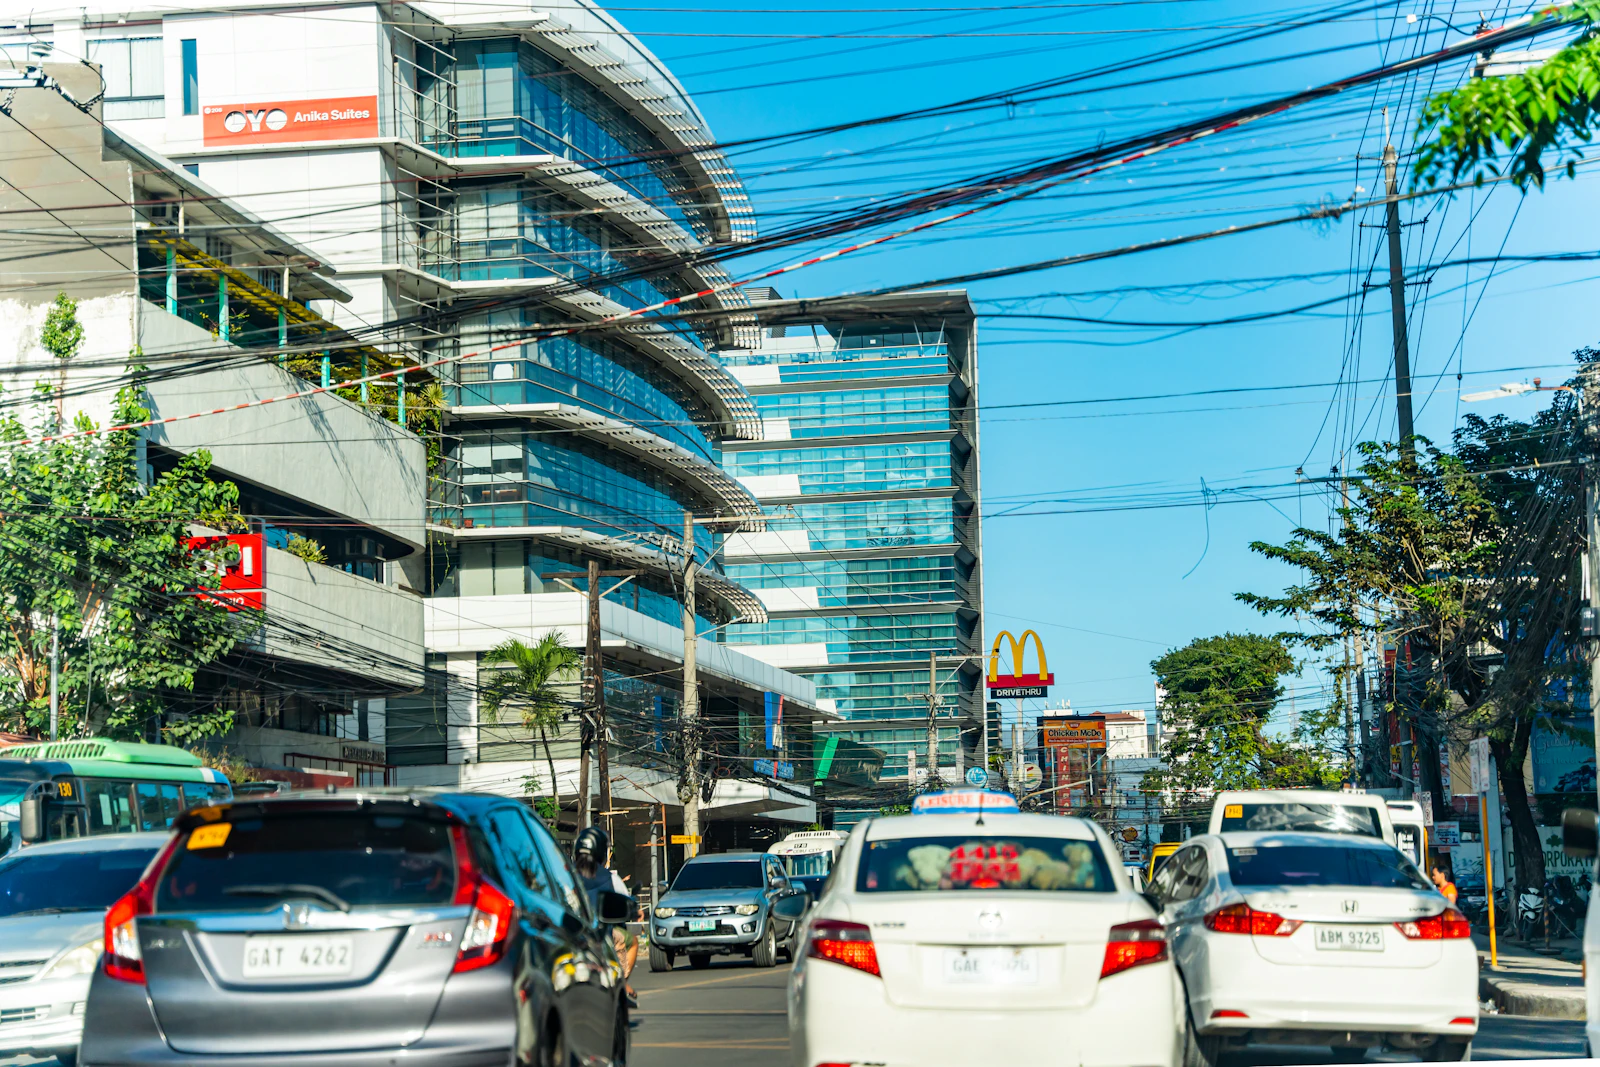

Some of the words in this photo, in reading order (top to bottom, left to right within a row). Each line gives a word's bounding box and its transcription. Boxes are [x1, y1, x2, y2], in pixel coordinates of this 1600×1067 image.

[224, 108, 288, 133] OYO
[294, 111, 329, 123] Anika
[331, 108, 370, 121] Suites
[1048, 729, 1079, 737] Chicken
[1080, 729, 1102, 737] McDo
[58, 781, 73, 797] 130
[1320, 931, 1344, 944] ABM
[1349, 931, 1381, 945] 9325
[248, 947, 284, 967] GAT
[300, 946, 349, 965] 4262
